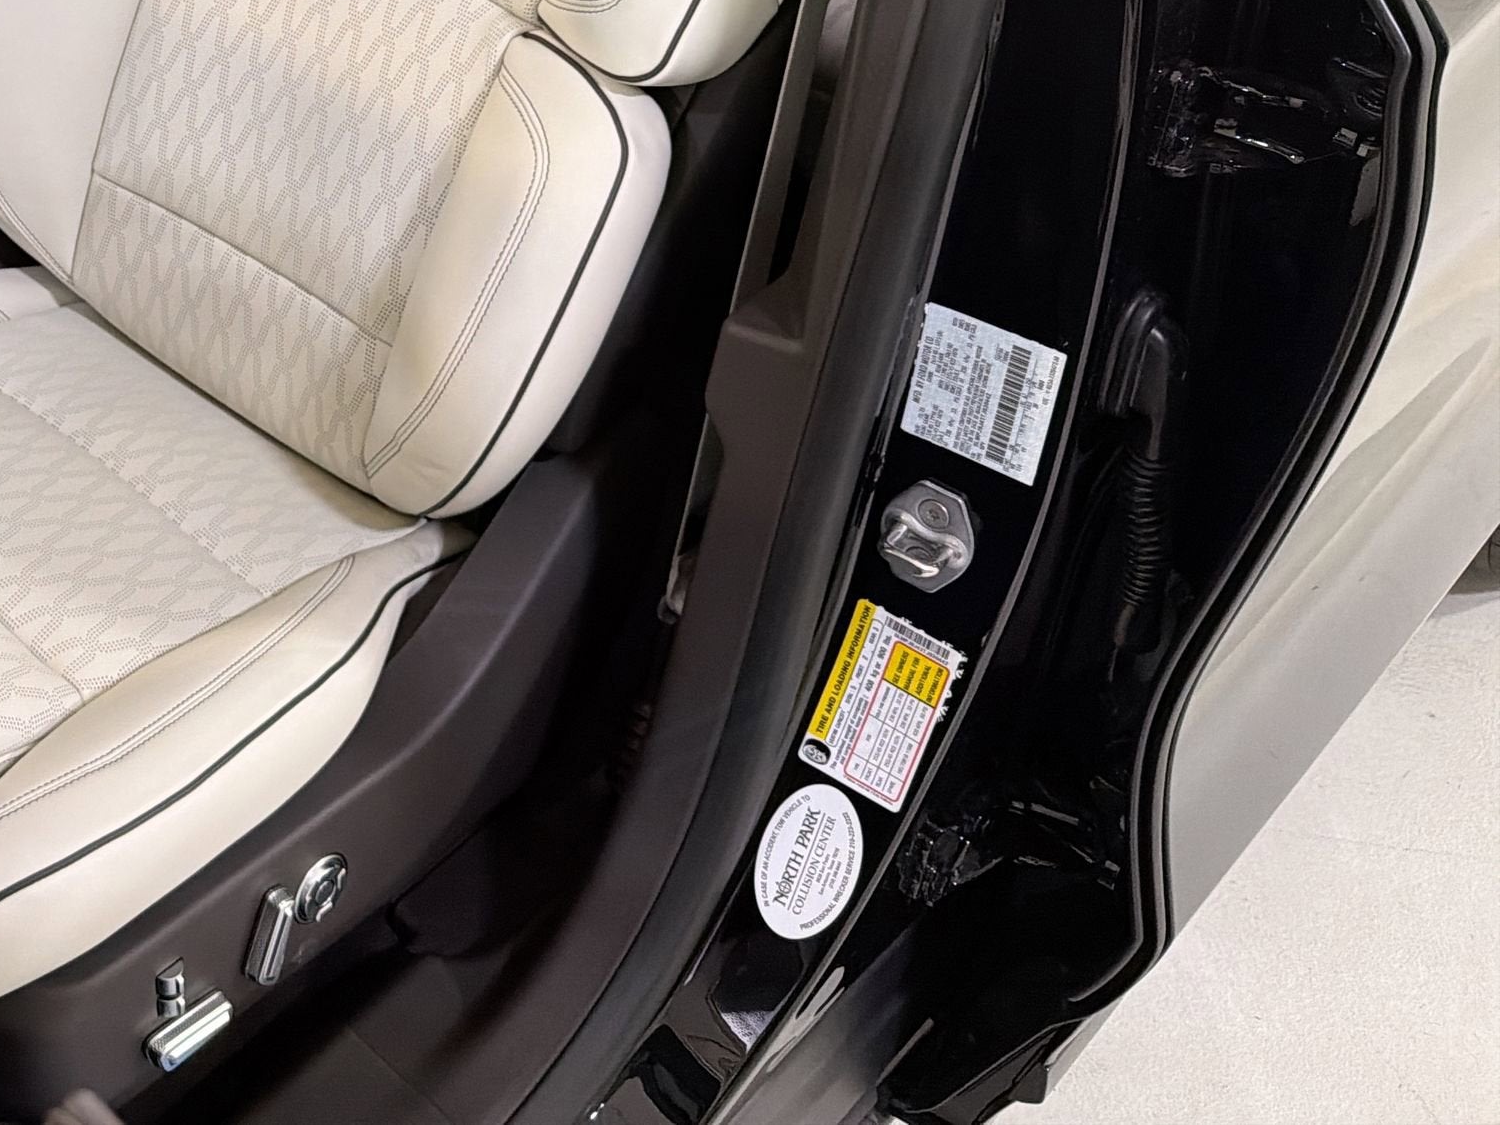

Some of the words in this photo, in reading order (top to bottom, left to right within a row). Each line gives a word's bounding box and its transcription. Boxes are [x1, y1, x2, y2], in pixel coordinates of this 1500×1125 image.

[815, 715, 829, 733] TIRE
[824, 695, 836, 715] AND
[831, 660, 851, 695] LOADING
[847, 604, 872, 659] INFORMATION
[801, 794, 811, 802] TO
[782, 799, 803, 819] VEHICLE
[774, 817, 786, 831] TOW
[762, 860, 769, 871] AN
[772, 850, 804, 907] NORTH
[795, 806, 821, 849] PARK
[792, 857, 821, 915] COLLISION
[814, 816, 837, 858] CENTER
[760, 871, 768, 880] OF
[760, 881, 768, 899] CASE
[799, 902, 836, 930] PROFESSIONAL
[832, 875, 849, 903] WRECKER
[845, 850, 855, 875] SERVICE
